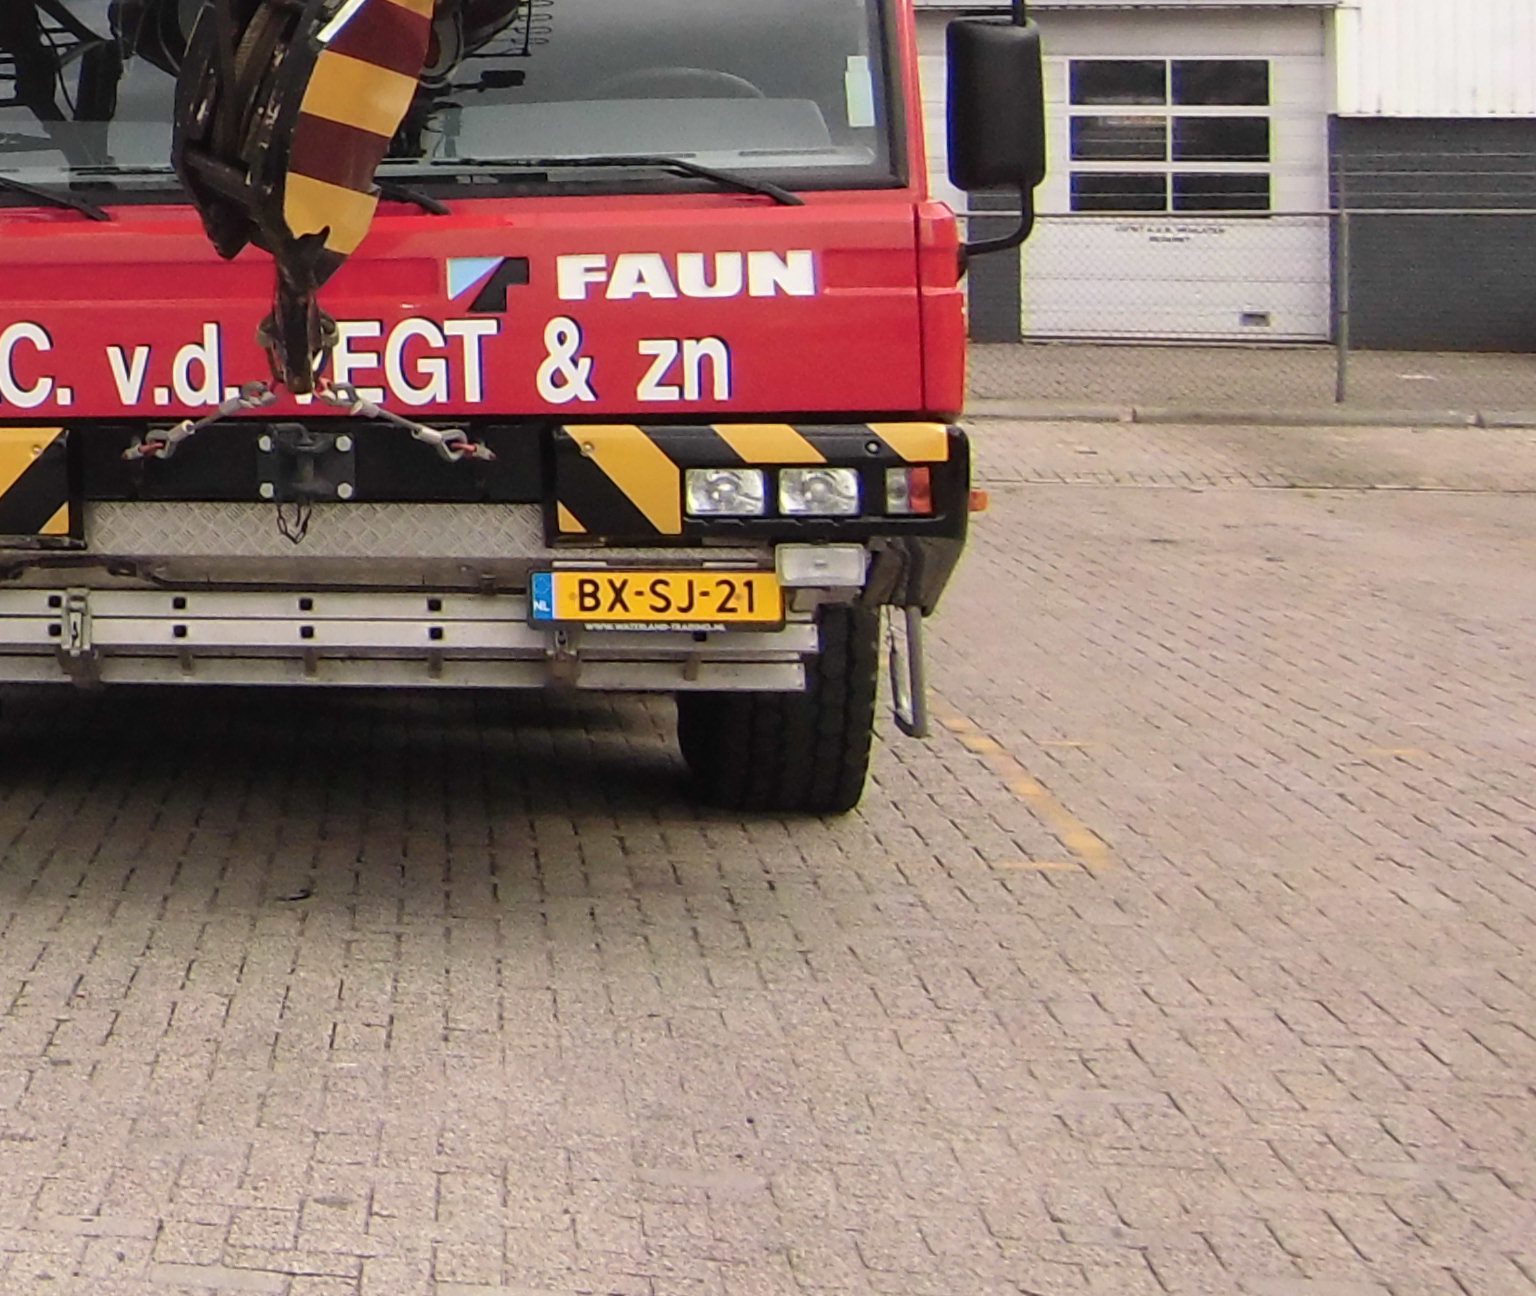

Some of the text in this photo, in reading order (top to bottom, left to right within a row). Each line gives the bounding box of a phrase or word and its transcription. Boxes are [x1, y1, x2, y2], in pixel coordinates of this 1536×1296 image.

[556, 250, 816, 300] FAUN
[106, 322, 240, 407] v.d.
[294, 317, 499, 406] EGT
[536, 316, 593, 404] &
[636, 336, 730, 402] zn
[578, 578, 755, 613] BX-SJ-21
